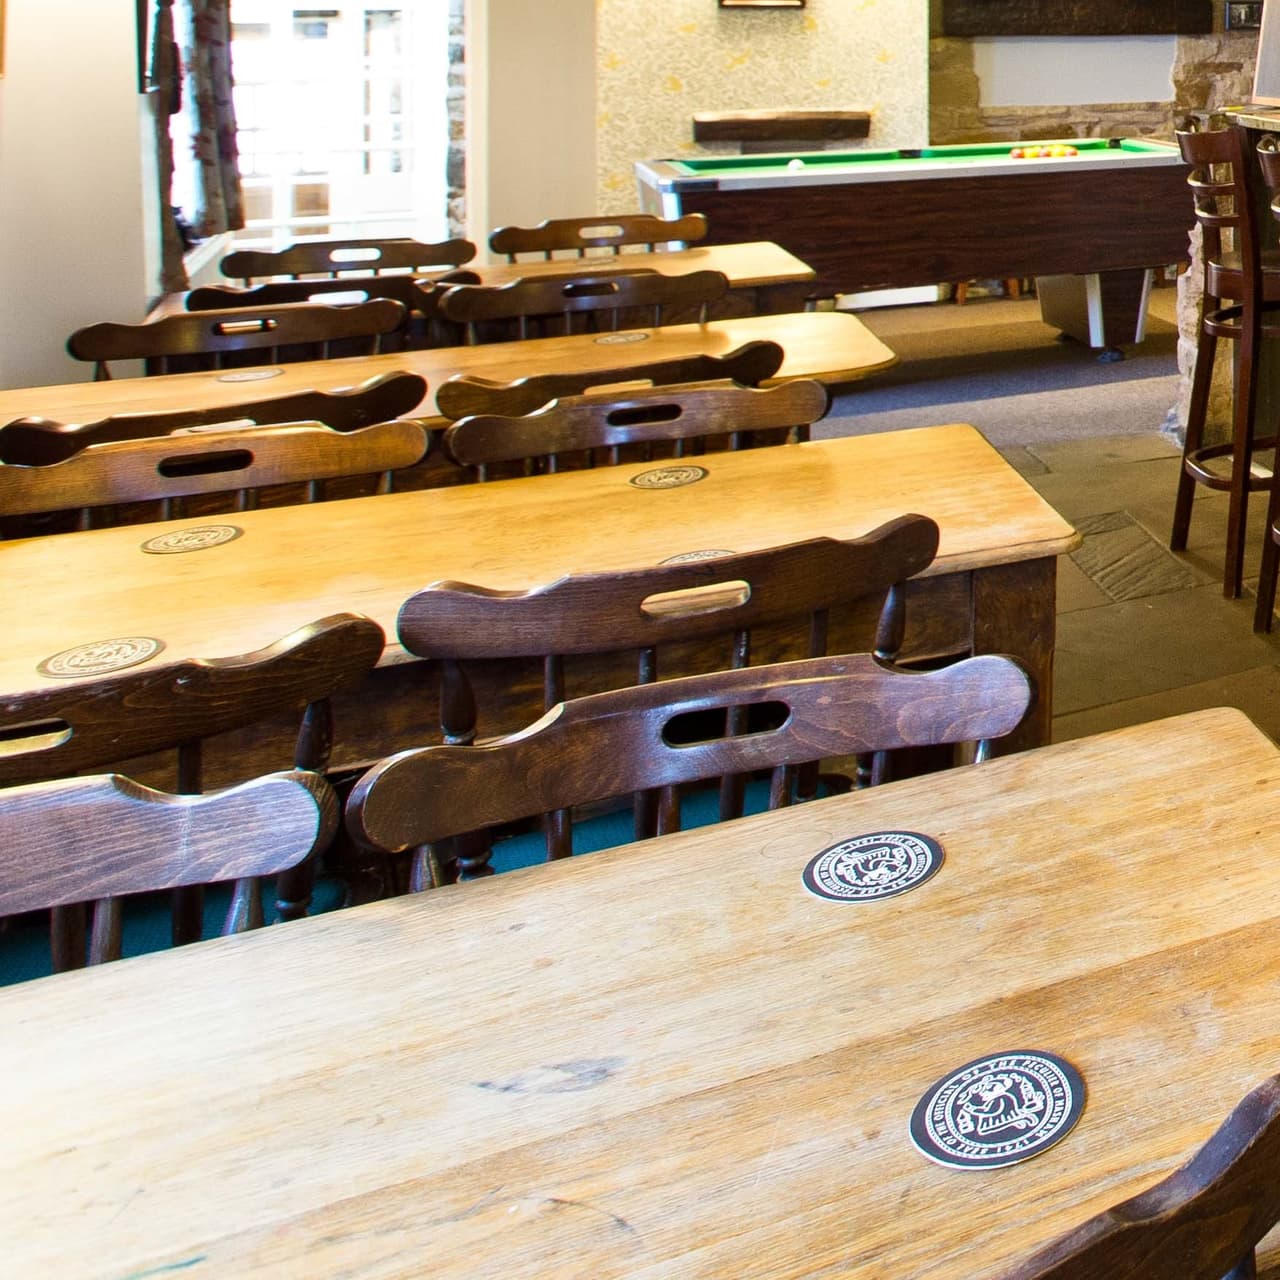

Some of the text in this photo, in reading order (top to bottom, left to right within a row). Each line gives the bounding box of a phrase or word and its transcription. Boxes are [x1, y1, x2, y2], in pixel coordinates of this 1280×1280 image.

[933, 1059, 1066, 1155] SEAL OF THE OFFICIAL OF THE PECULIER OF MASHAM 1741
